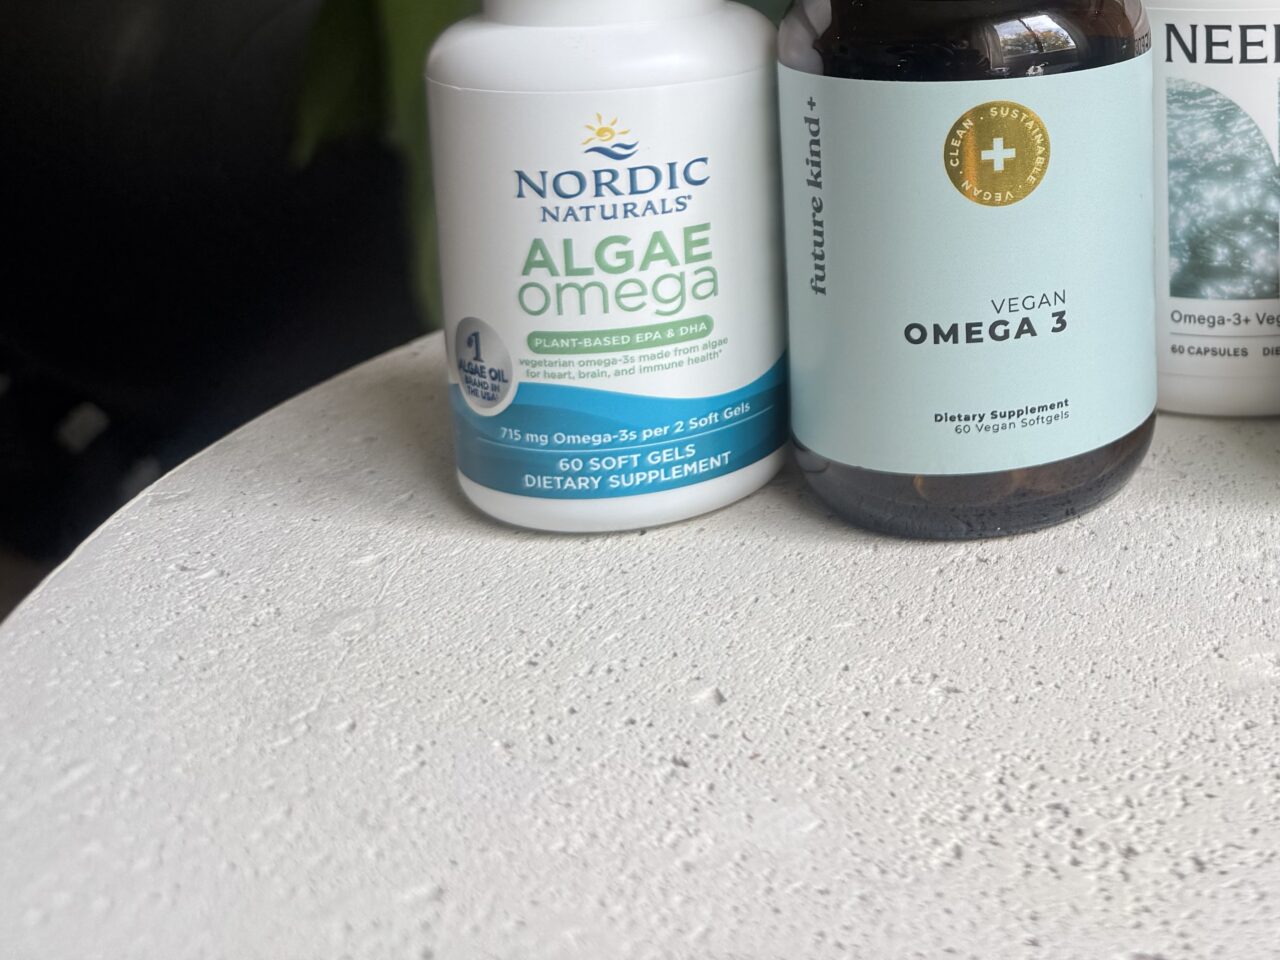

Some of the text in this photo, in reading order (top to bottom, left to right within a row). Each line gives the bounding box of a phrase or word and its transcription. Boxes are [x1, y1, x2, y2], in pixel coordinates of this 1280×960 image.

[804, 115, 824, 190] kind
[950, 106, 1046, 203] CLEAN SUSTAINABLE VEGAN
[513, 157, 711, 200] NORDIC
[521, 222, 714, 277] ALGAE
[810, 196, 828, 297] future
[518, 265, 720, 317] omega
[991, 289, 1067, 315] VEGAN
[904, 310, 1068, 345] OMEGA 3
[1170, 309, 1251, 326] Omega-3+
[534, 321, 708, 349] PLANT-BASED EPA & DHA
[1170, 343, 1185, 355] 60
[1188, 344, 1249, 357] CAPSULES
[519, 336, 729, 370] vegetarian omega-3s made from algae
[459, 358, 509, 383] ALGAE OIL
[464, 374, 489, 390] BRAND
[526, 369, 541, 379] for
[543, 368, 572, 381] heart,
[574, 366, 612, 380] brain,
[614, 363, 637, 377] and
[639, 358, 685, 375] immune
[500, 401, 751, 446] 715 mg Omega-3s per 2 Soft Gels
[934, 398, 1070, 424] Dietary Supplement
[954, 410, 1070, 435] 60 Vegan Softgels
[524, 450, 732, 490] DIETARY SUPPLEMENT
[559, 444, 696, 472] 60 SOFT GELS
